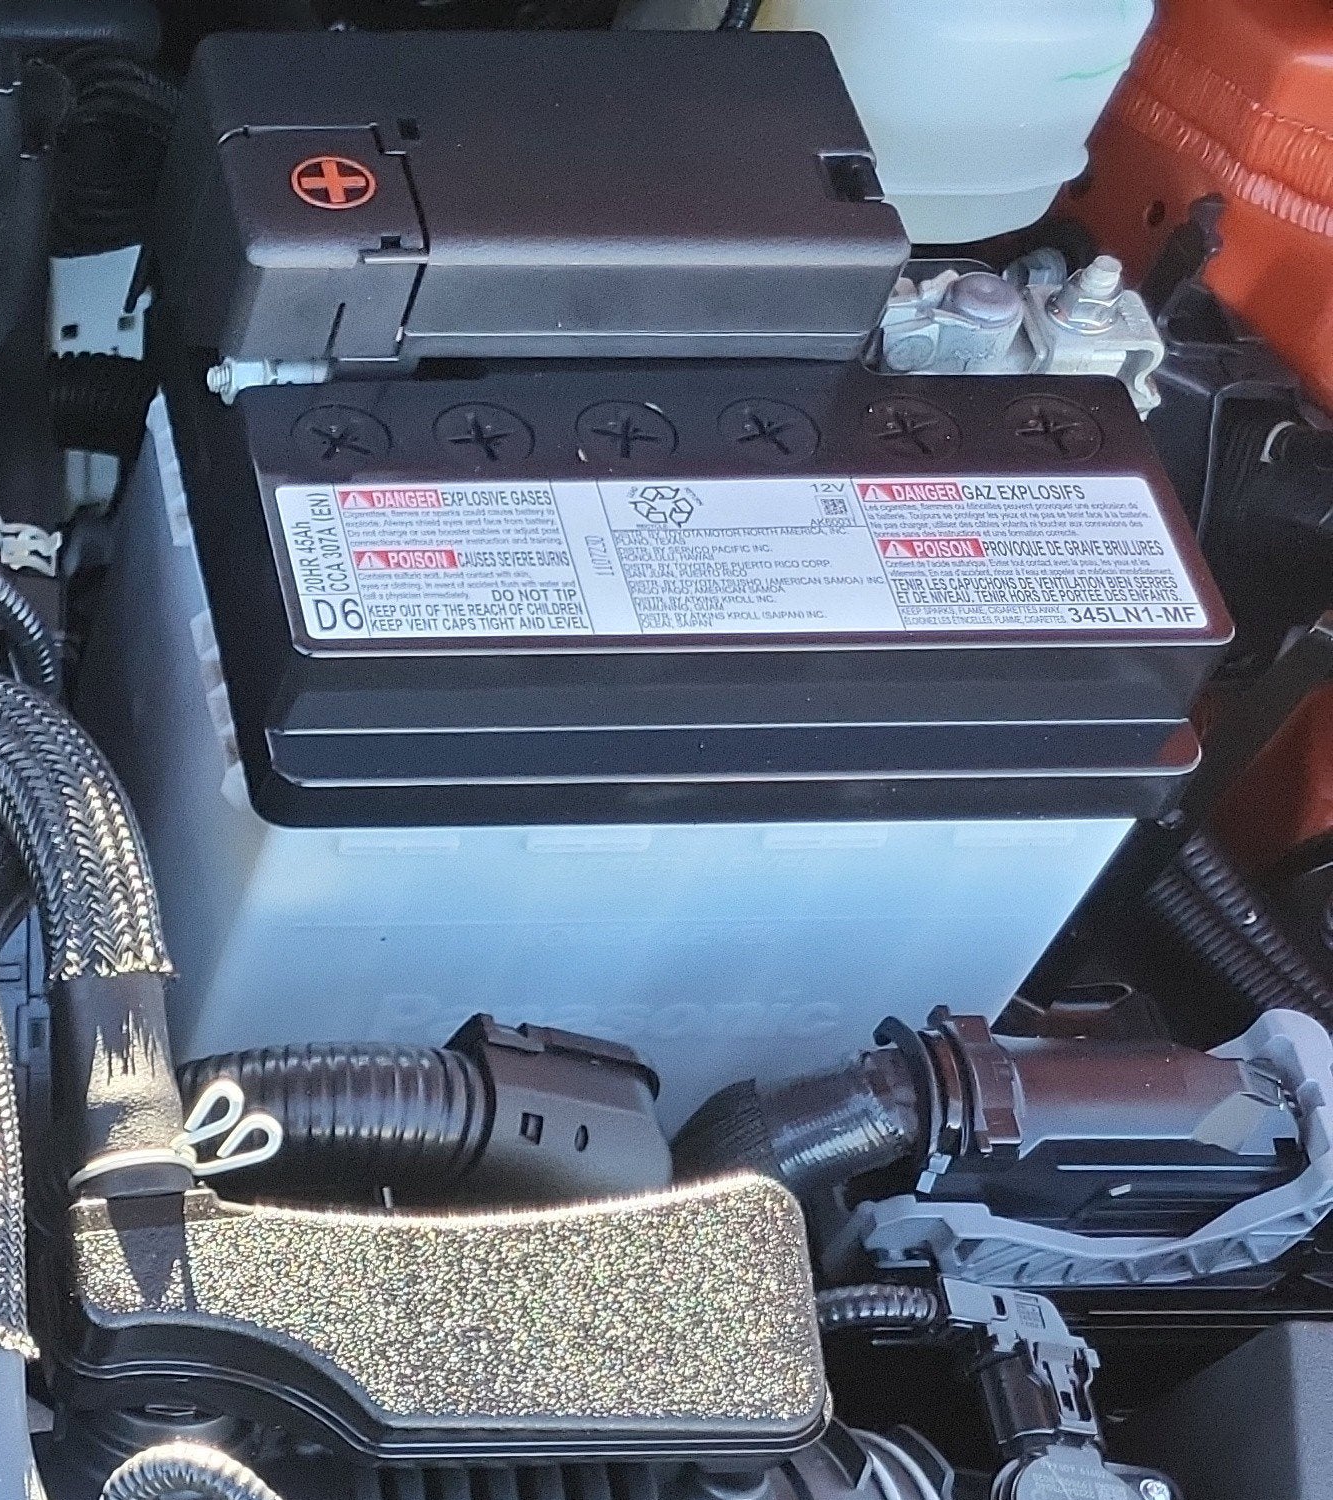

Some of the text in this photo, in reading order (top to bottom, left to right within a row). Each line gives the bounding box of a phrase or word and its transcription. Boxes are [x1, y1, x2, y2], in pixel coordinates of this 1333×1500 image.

[810, 483, 845, 493] 12V
[892, 484, 1085, 501] DANGER GAZ EXPLOSIFS
[372, 490, 552, 508] DANGER EXPLOSIVE GASES
[306, 492, 350, 592] CCA 307A (EN)
[913, 540, 1165, 558] POISON PROVOQUE DE GRAVE BRULURES
[291, 521, 326, 593] 20HR 45Ah
[387, 550, 571, 569] POISON CAUSES SEVERE BURNS
[774, 560, 799, 568] RICO
[891, 575, 1178, 591] TENIR LES CAPUCHONS DE VENTILATION BIEN SERRES
[491, 588, 577, 602] DO NOT TIP
[896, 588, 1183, 604] ET DE NIVEAU. TENIR HORS DE PORTEE DES ENFANTS.
[313, 598, 364, 631] D6
[367, 602, 585, 618] KEEP OUT OF THE REACH OF CHILDREN
[1068, 606, 1196, 623] 345LN1-MF
[372, 616, 589, 632] KEEP VENT CAPS TIGHT AND LEVEL
